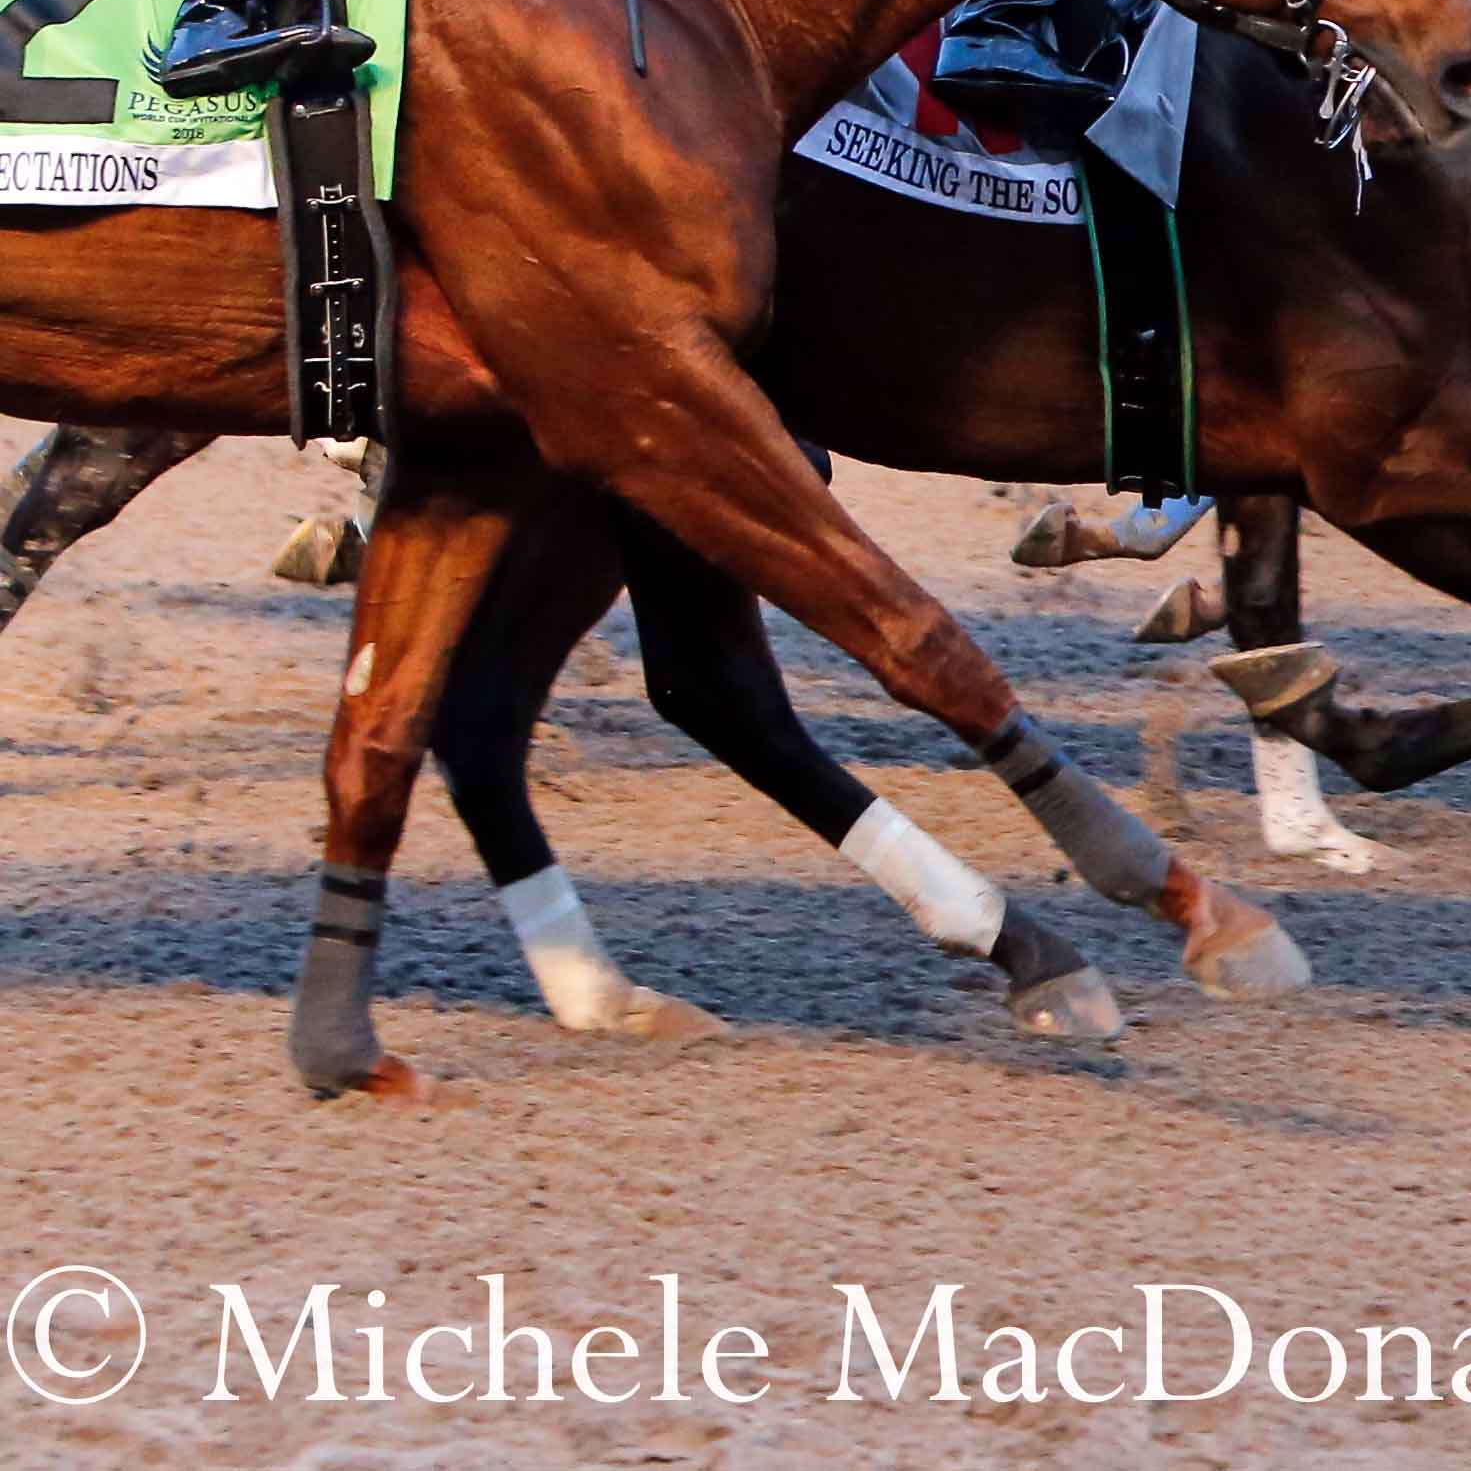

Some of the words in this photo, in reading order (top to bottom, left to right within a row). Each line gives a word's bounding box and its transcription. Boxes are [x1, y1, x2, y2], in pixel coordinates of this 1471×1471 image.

[127, 90, 257, 117] PEGASUS
[172, 128, 205, 140] 2018
[826, 118, 961, 197] SEEKING
[969, 170, 1034, 213] THE
